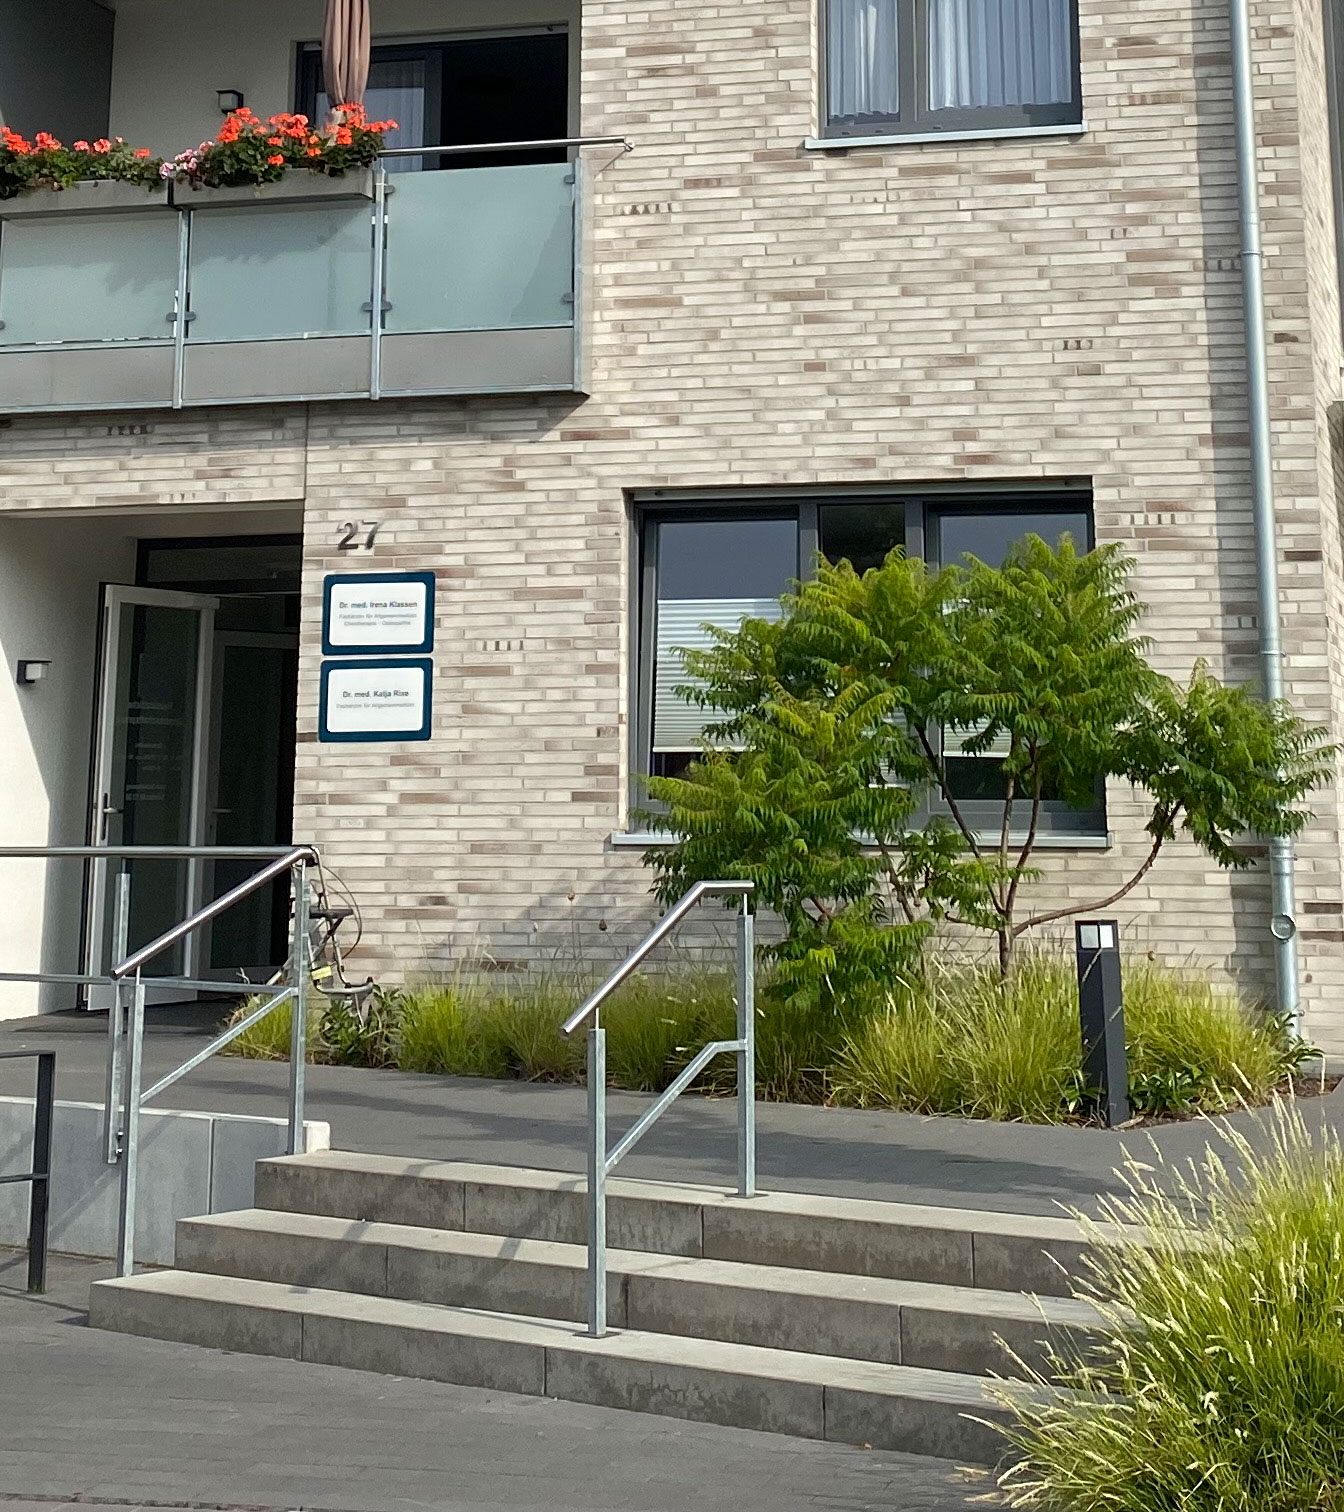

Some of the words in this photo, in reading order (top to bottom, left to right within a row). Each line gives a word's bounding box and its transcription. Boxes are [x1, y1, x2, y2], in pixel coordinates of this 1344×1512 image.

[337, 519, 383, 550] 27
[389, 600, 418, 608] Klassen
[373, 690, 392, 699] Katja
